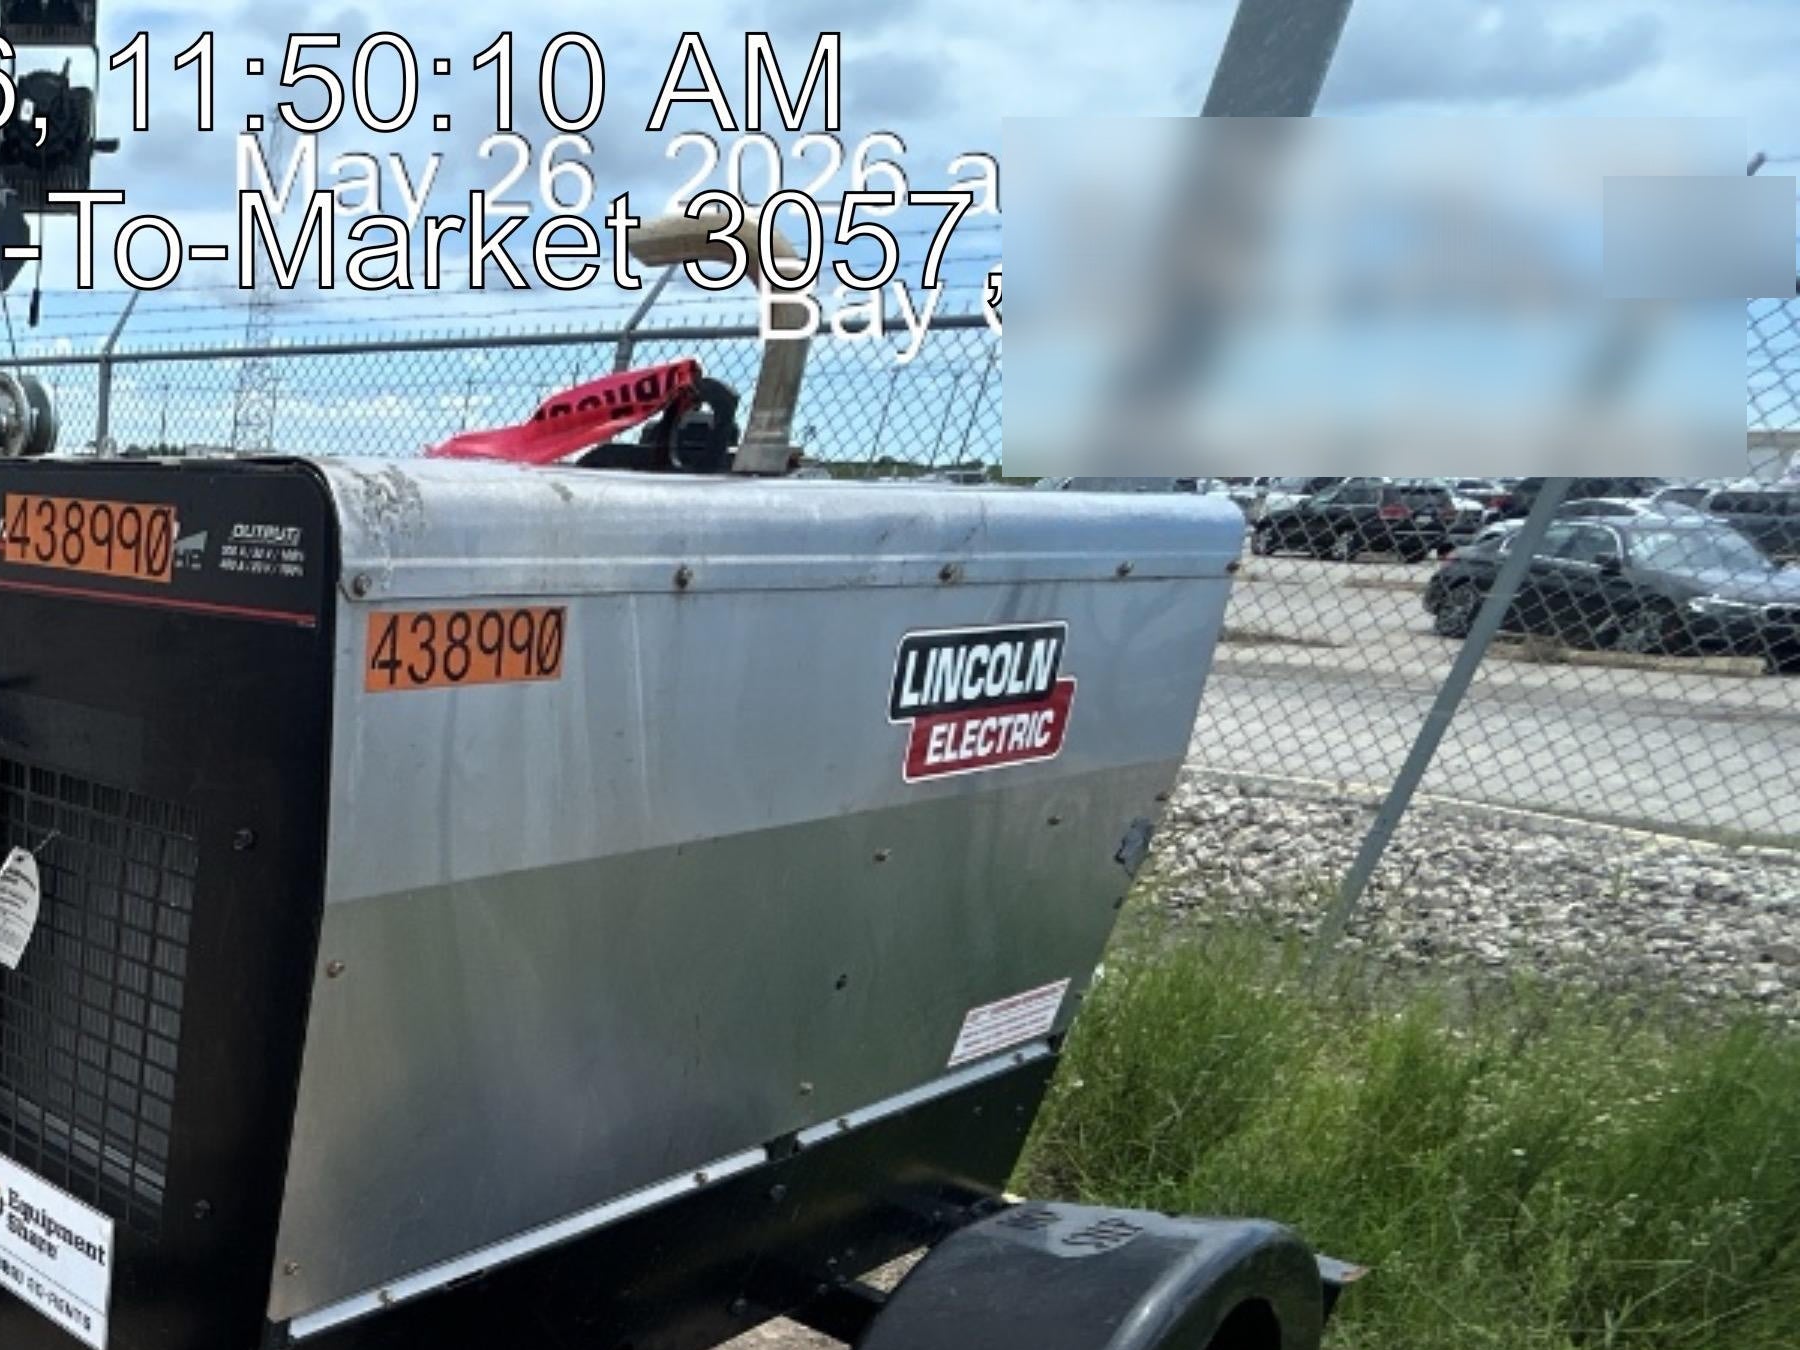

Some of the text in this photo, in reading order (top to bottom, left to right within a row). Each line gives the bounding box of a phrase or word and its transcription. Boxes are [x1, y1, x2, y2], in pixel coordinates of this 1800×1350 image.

[7, 497, 173, 577] 438990
[371, 606, 566, 685] 438990
[900, 638, 1058, 709] LINCOLN
[924, 709, 1054, 766] ELECTRIC
[6, 1211, 58, 1260] Share
[7, 1187, 106, 1267] Equipment
